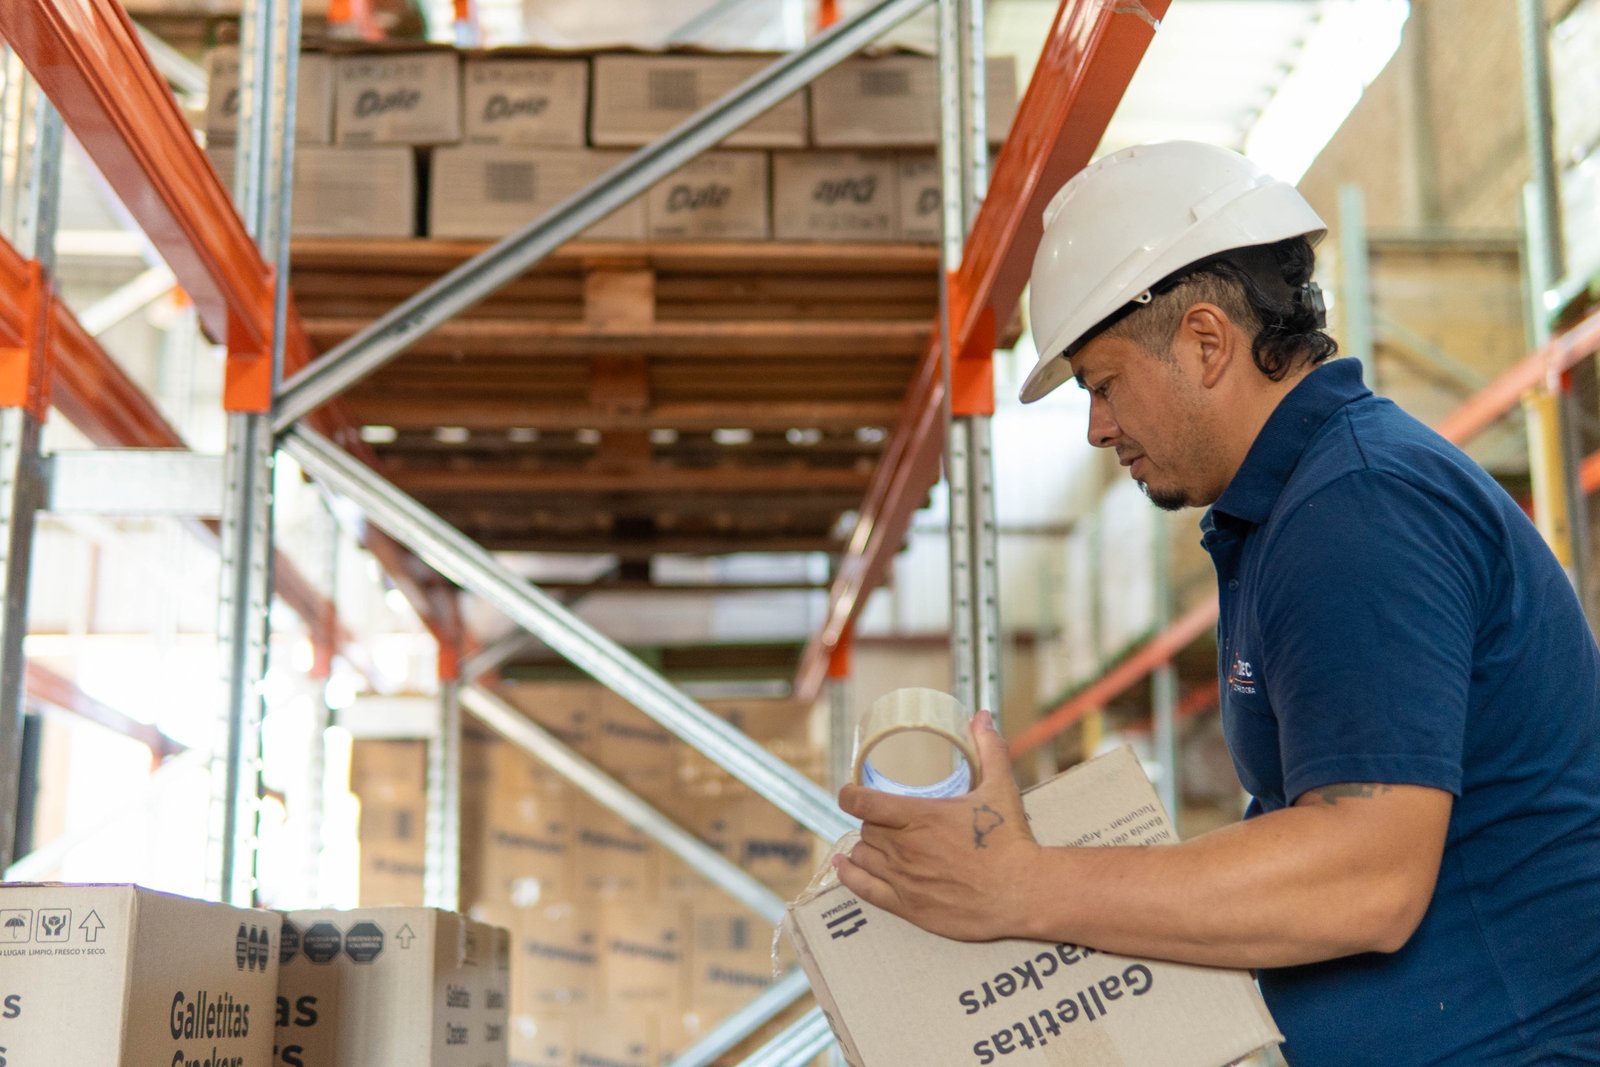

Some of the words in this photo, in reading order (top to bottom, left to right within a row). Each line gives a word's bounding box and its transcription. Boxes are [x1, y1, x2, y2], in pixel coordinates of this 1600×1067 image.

[3, 949, 26, 957] LUGAR
[54, 948, 80, 956] FRESCO
[170, 990, 249, 1040] Galletitas
[973, 963, 1153, 1065] Galletitas
